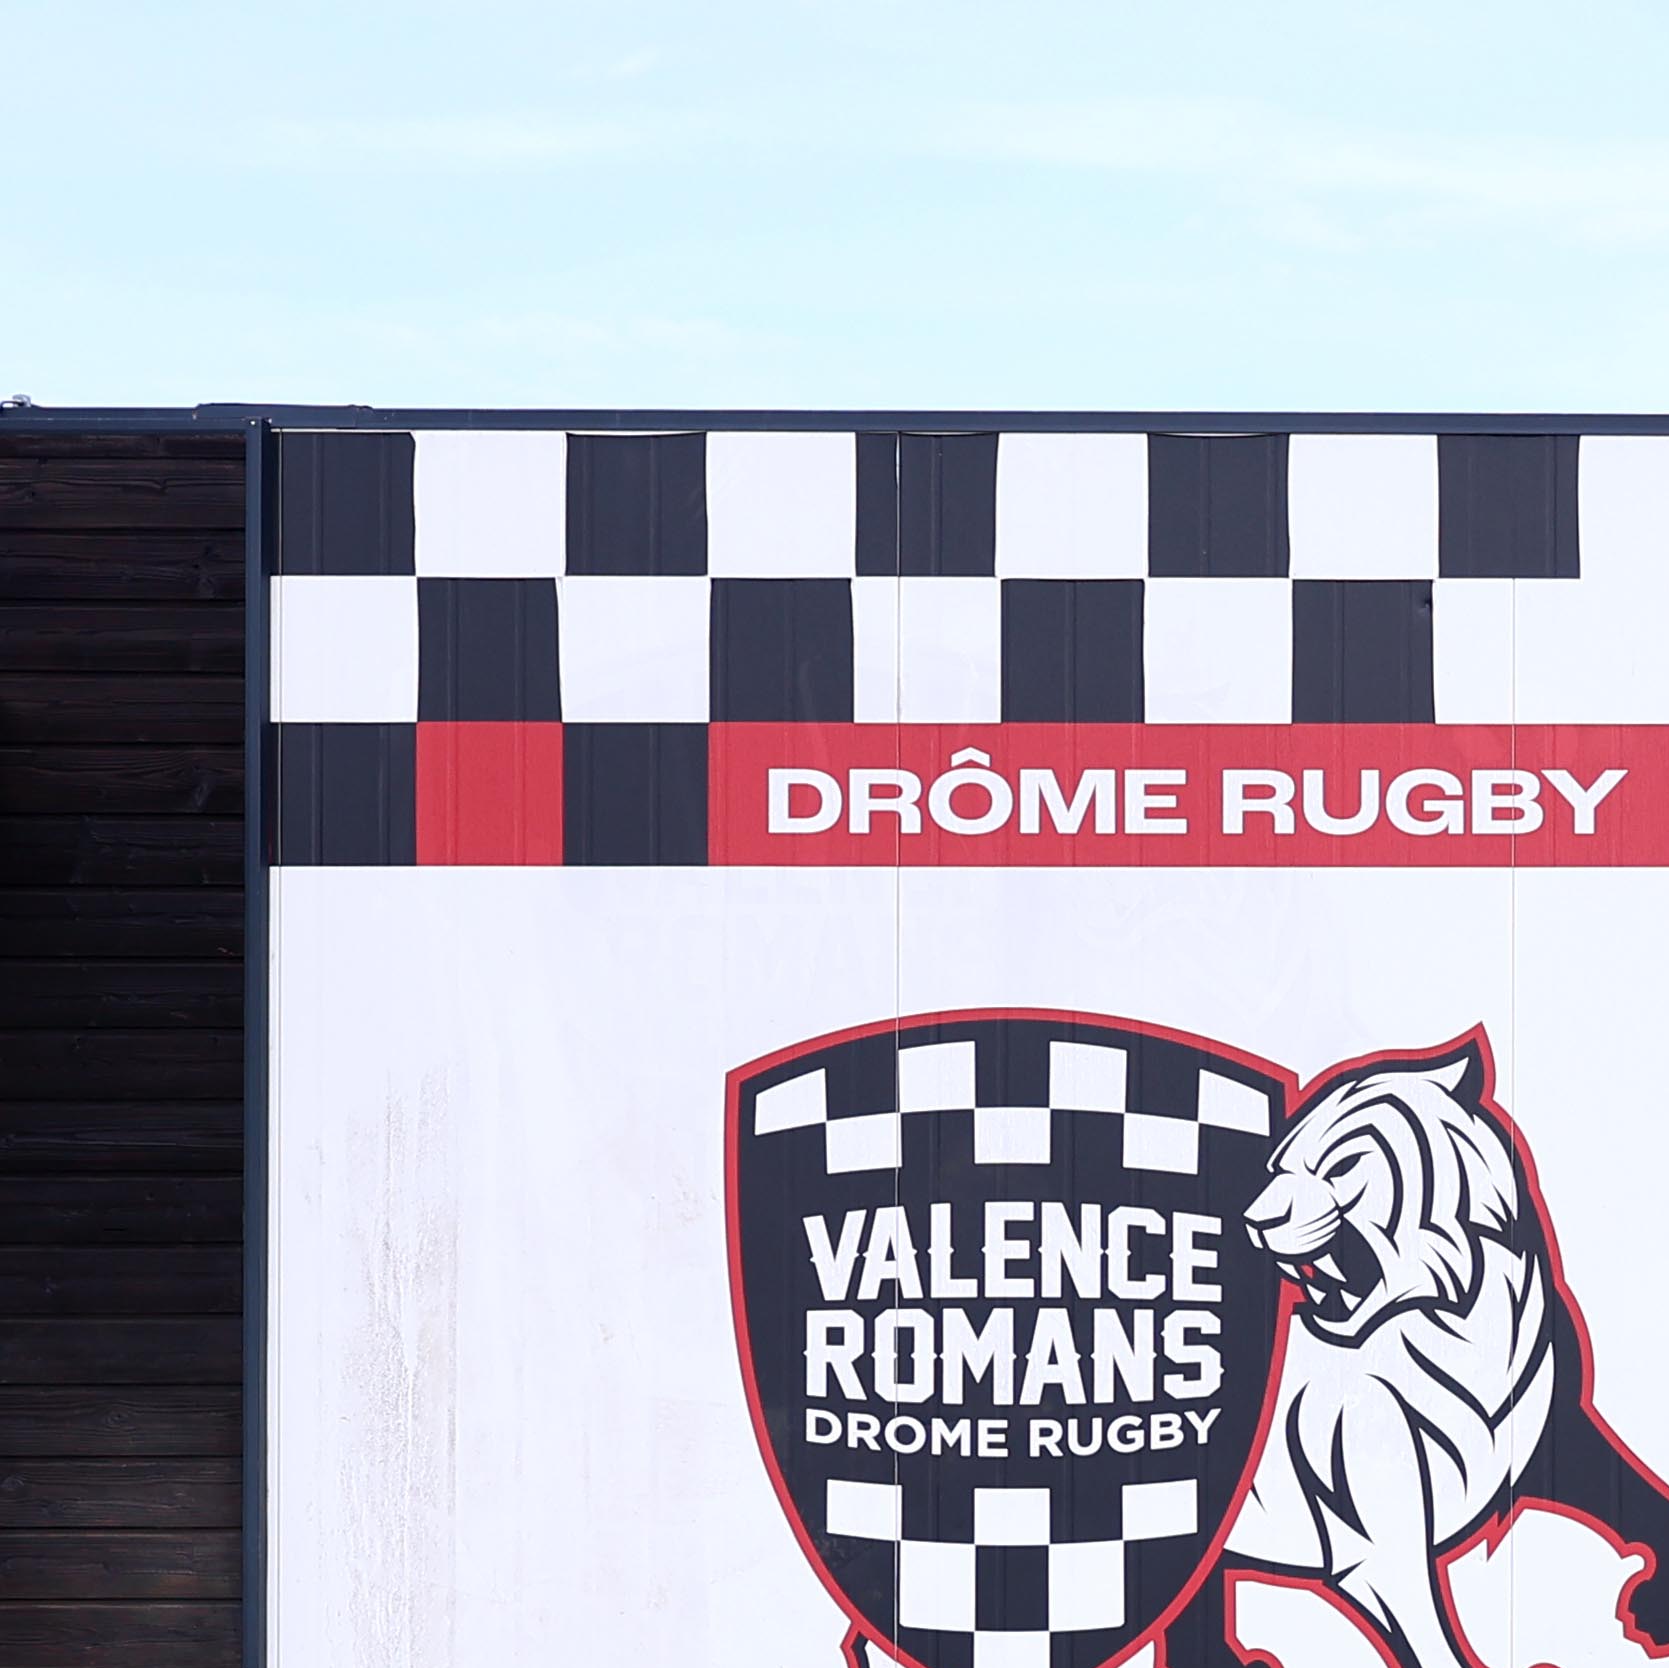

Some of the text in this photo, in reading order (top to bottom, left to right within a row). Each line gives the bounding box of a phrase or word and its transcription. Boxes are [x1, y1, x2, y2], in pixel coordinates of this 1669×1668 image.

[767, 747, 1629, 836] DRÔME RUGBY
[803, 1201, 1222, 1302] VALENCE
[803, 1307, 1225, 1405] ROMANS
[805, 1407, 1221, 1457] DROME RUGBY
